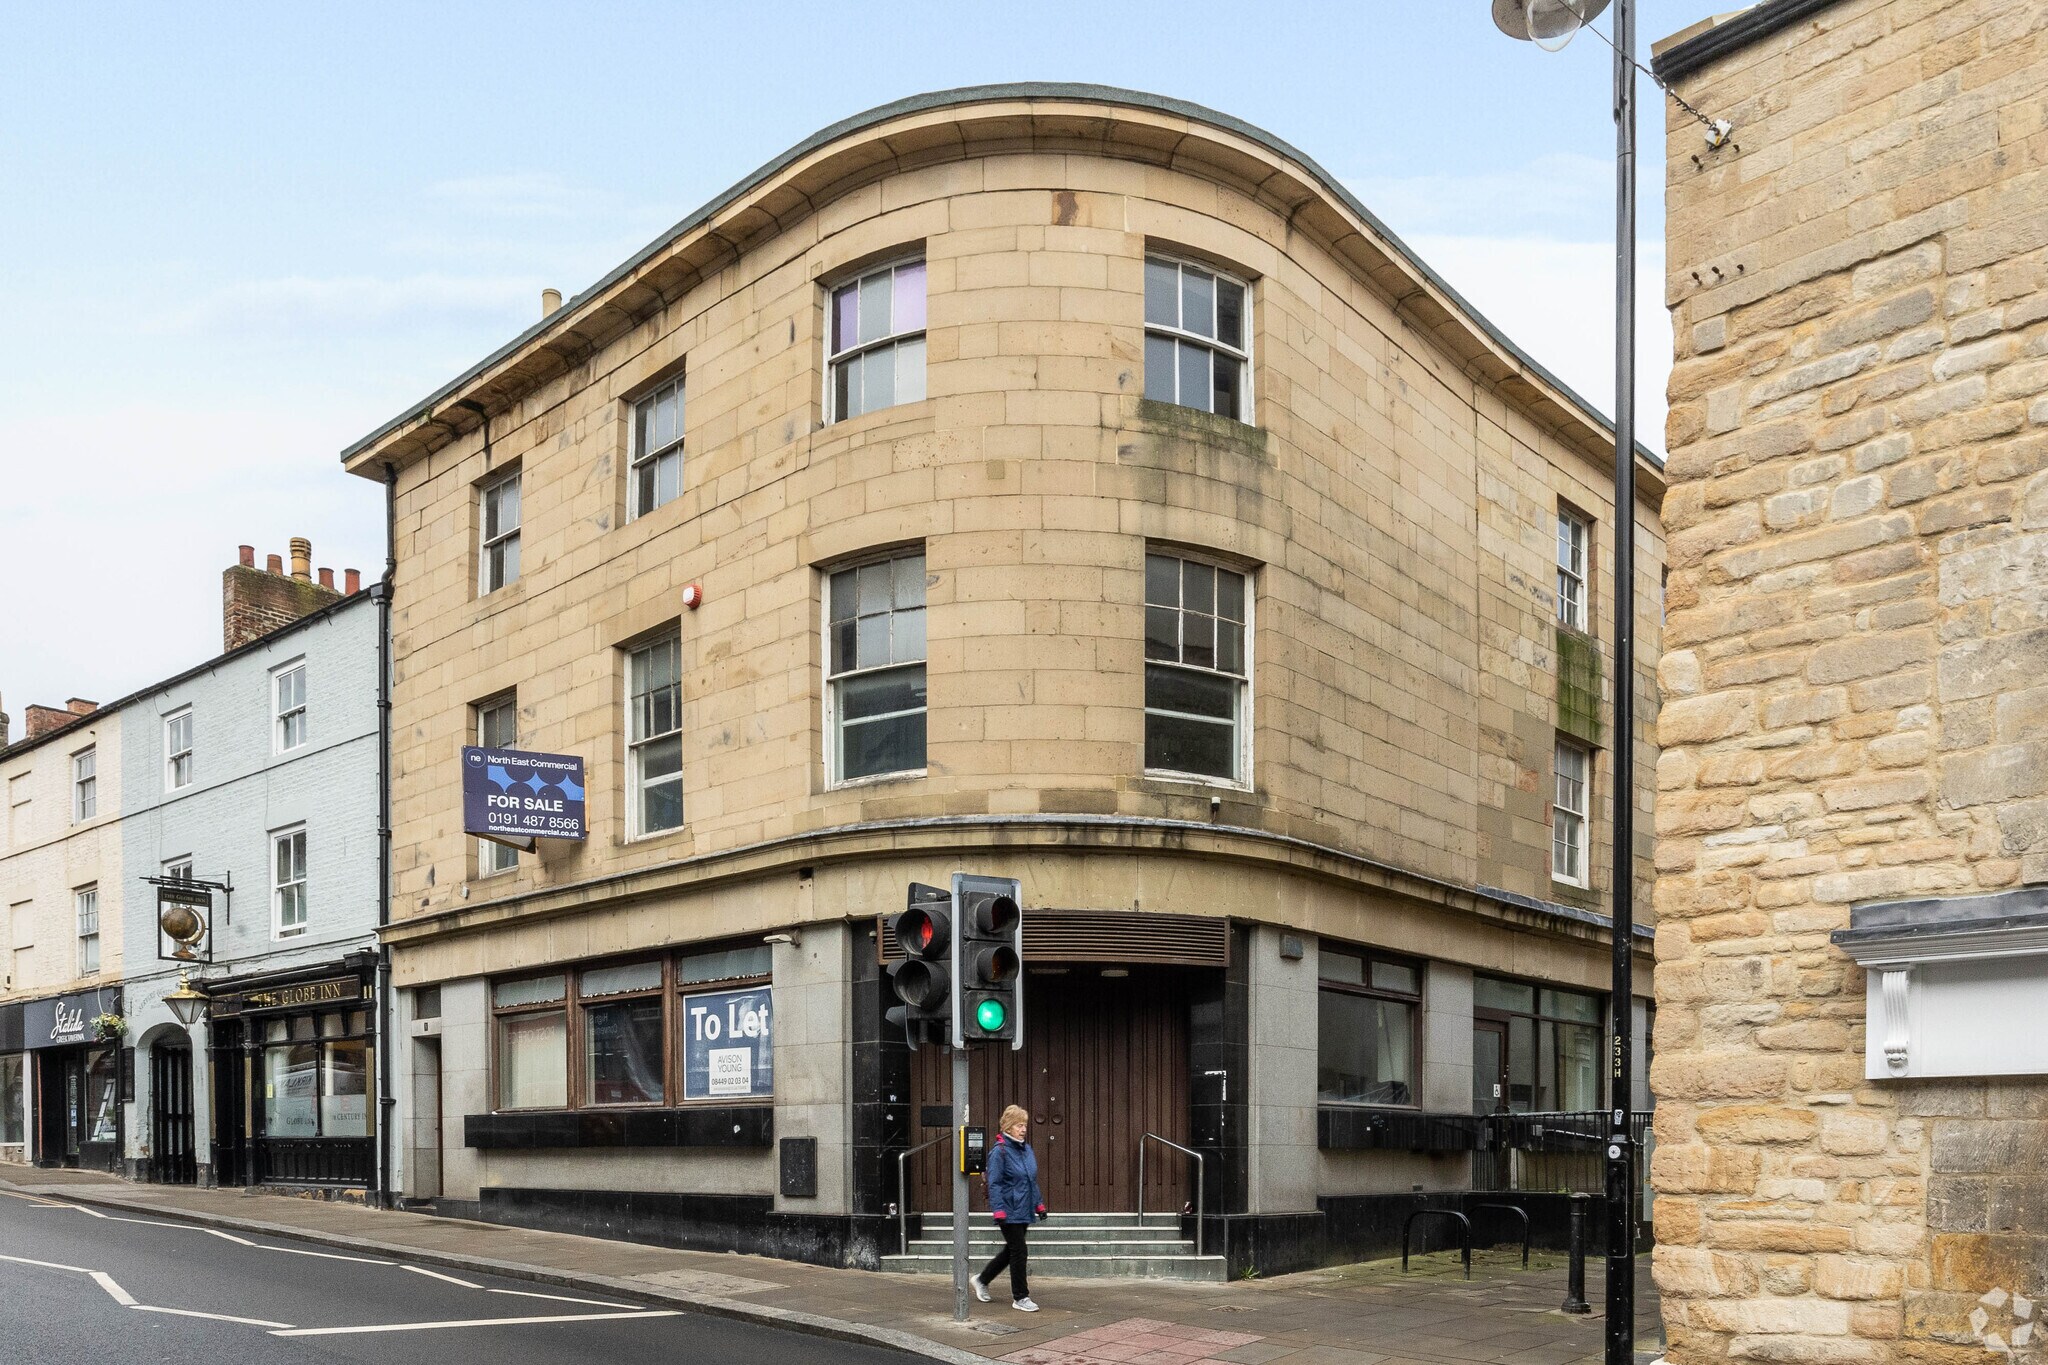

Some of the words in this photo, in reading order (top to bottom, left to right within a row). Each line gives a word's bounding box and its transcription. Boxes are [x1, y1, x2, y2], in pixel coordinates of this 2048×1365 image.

[487, 755, 511, 765] North
[511, 757, 529, 766] East
[530, 759, 578, 771] Commercial
[487, 795, 520, 809] FOR
[524, 799, 564, 812] SALE
[488, 812, 518, 825] 0191
[523, 815, 545, 827] 487
[549, 817, 579, 830] 8566
[488, 825, 580, 837] northeastcommercial.co.uk
[282, 986, 316, 1006] GLOBE
[320, 983, 341, 999] INN
[50, 1001, 85, 1040] Stalida
[690, 1006, 721, 1041] To
[729, 1003, 769, 1039] Let
[717, 1054, 743, 1064] AVISON
[717, 1063, 743, 1073] YOUNG
[711, 1077, 728, 1086] 08449
[728, 1077, 735, 1085] 02
[735, 1077, 742, 1085] 03
[742, 1076, 749, 1084] 04
